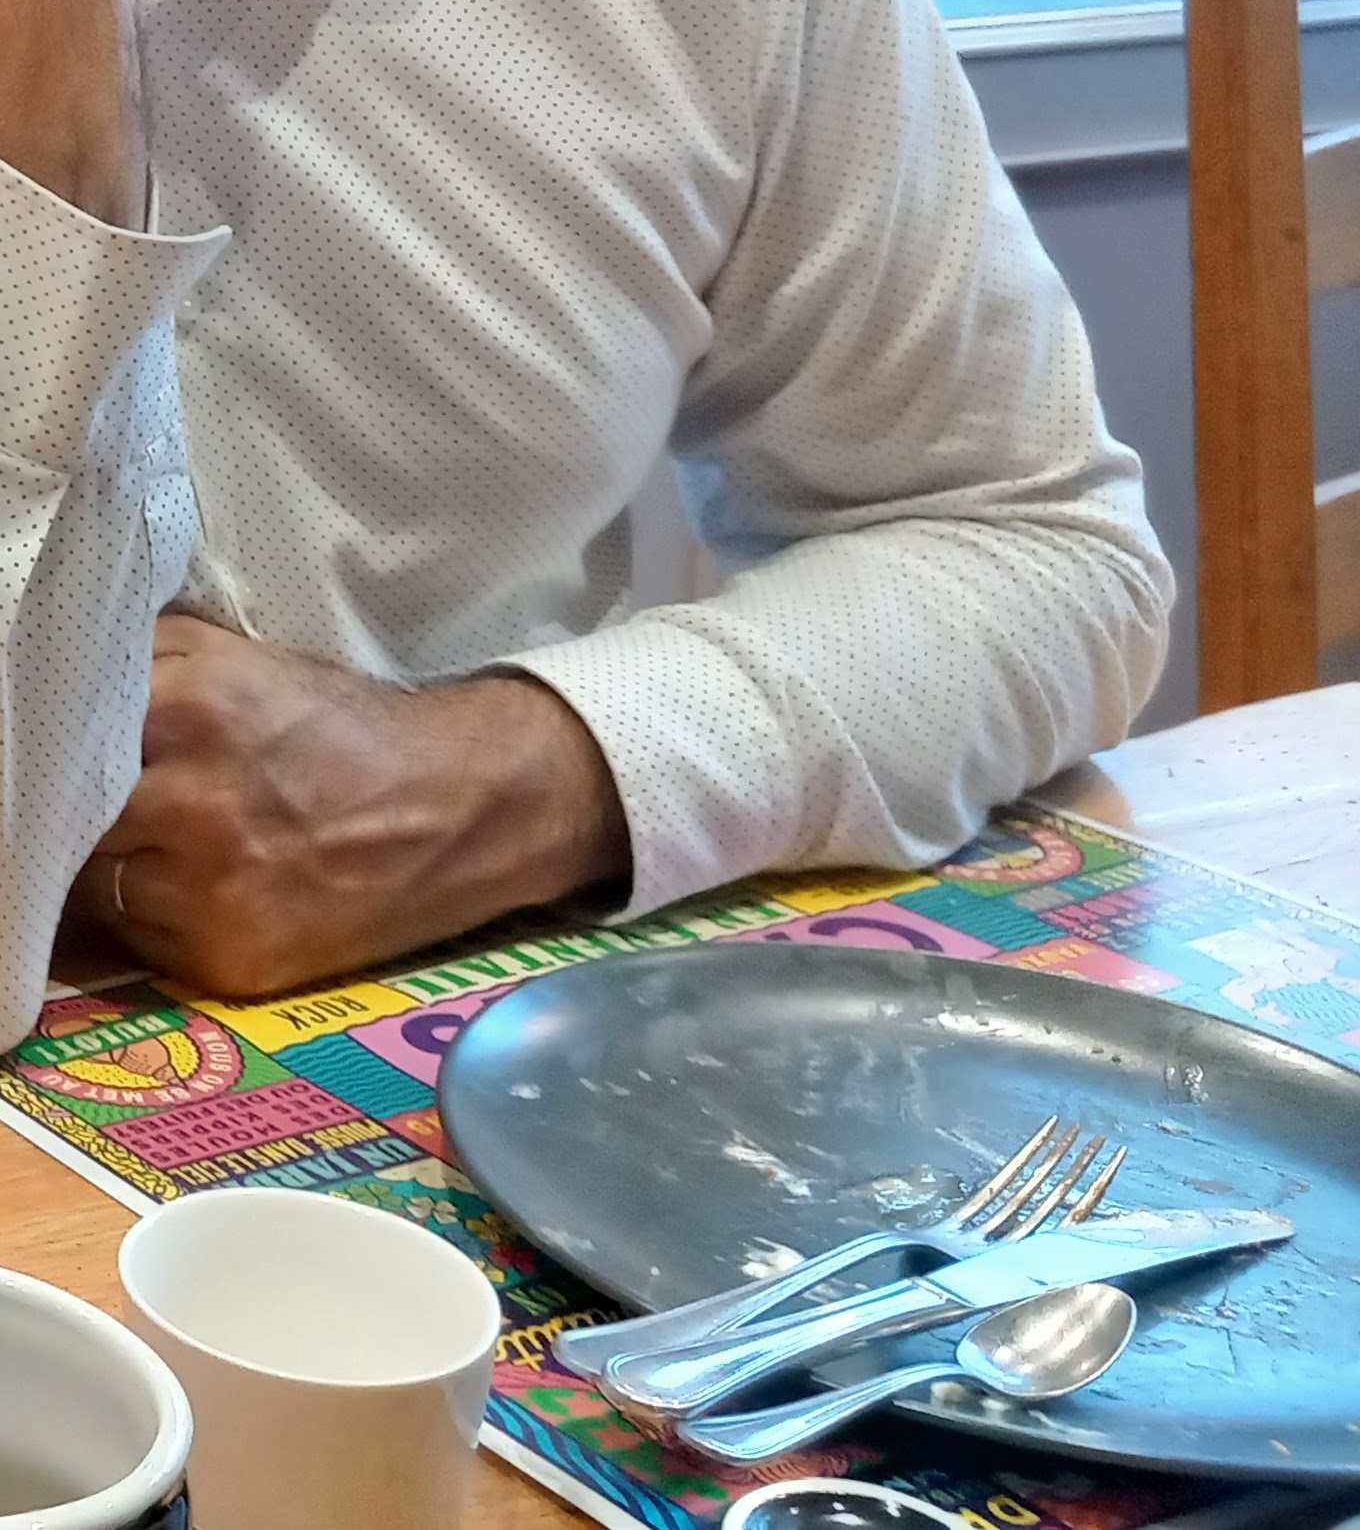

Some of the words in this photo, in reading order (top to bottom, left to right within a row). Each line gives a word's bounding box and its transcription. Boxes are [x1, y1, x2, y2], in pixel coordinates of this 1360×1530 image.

[271, 996, 370, 1031] ROCK
[40, 1074, 83, 1091] AU
[83, 1087, 146, 1104] MET
[191, 1073, 225, 1094] ON
[270, 1083, 312, 1103] OU
[216, 1091, 270, 1114] DES
[272, 1094, 333, 1116] DES
[289, 1104, 354, 1127] DES
[129, 1110, 264, 1152] KIPPERS
[148, 1122, 284, 1164] MOULES
[303, 1117, 391, 1152] POUSSE
[218, 1147, 254, 1175] LE
[251, 1137, 316, 1167] DANS
[350, 1137, 424, 1167] UN
[166, 1157, 229, 1187] CIEL
